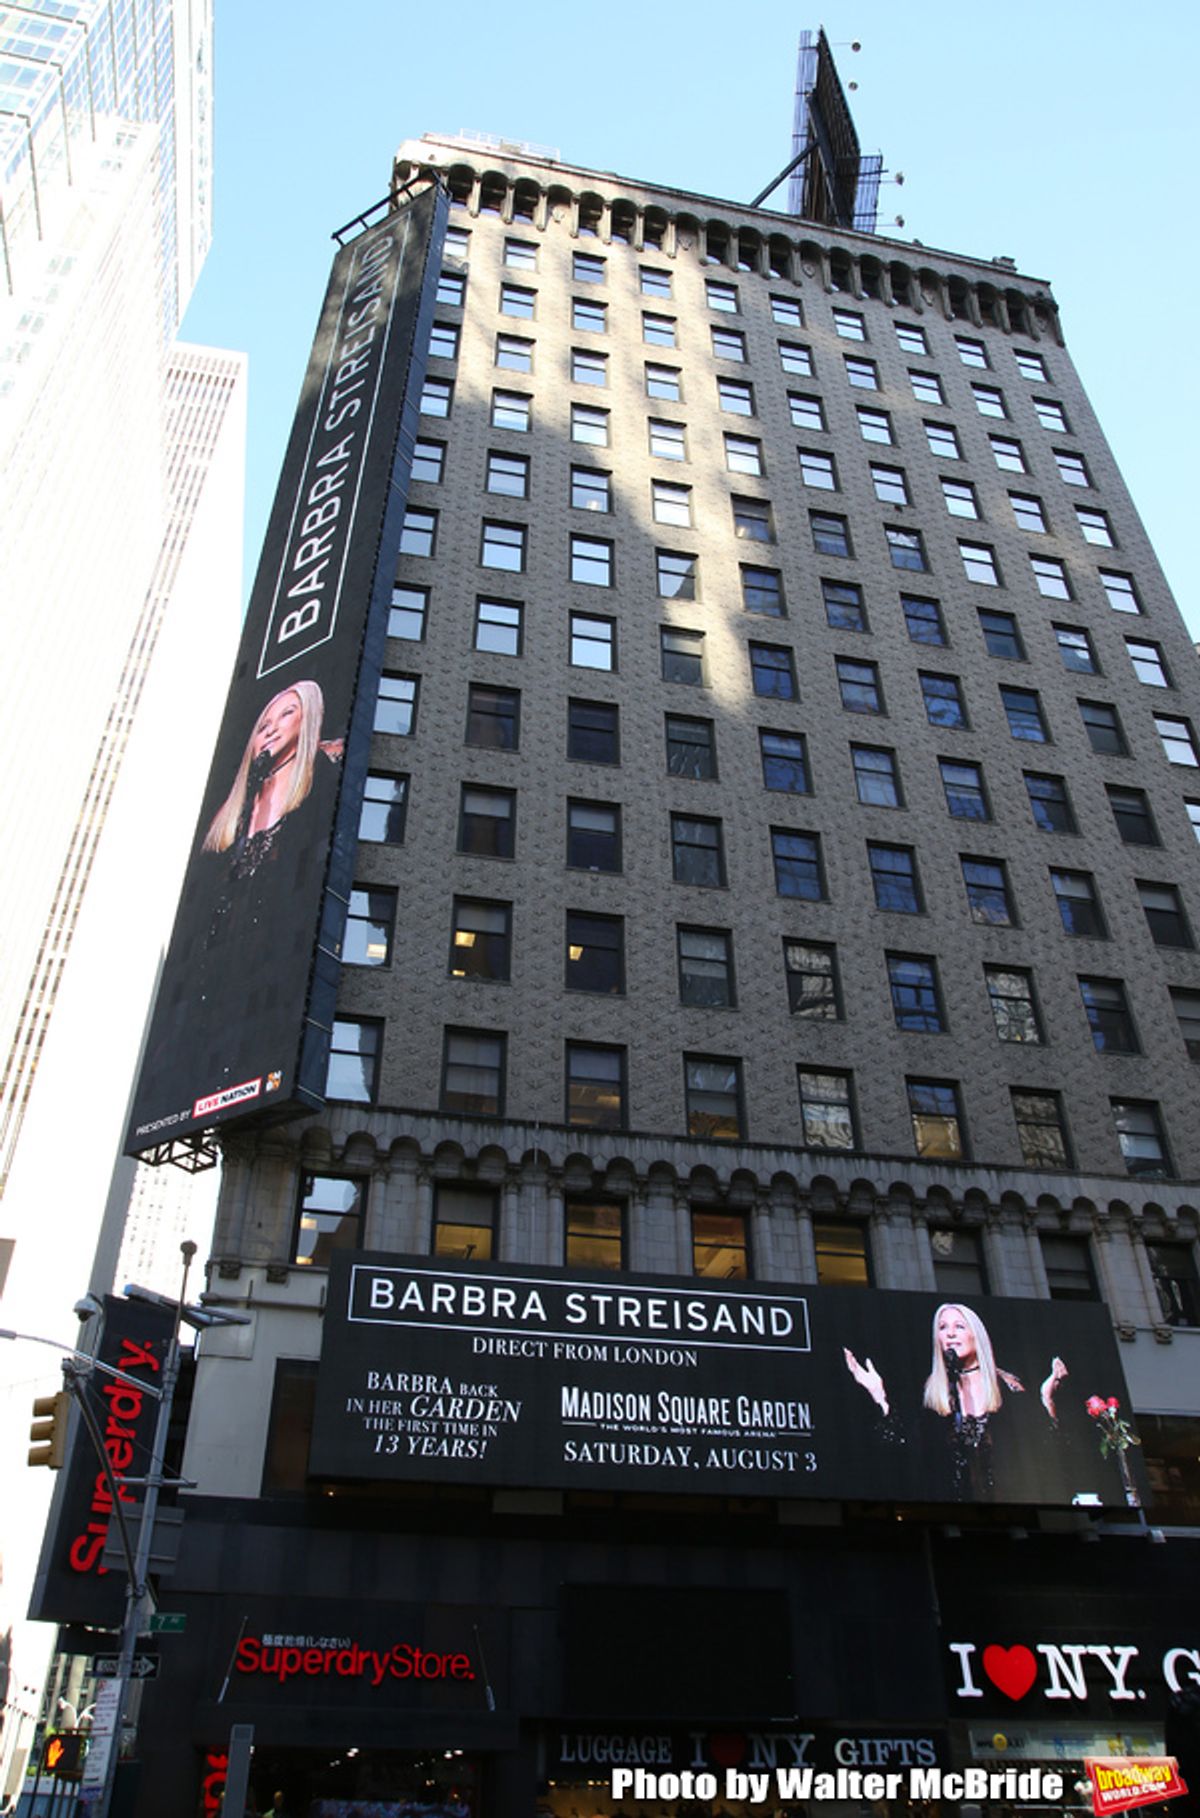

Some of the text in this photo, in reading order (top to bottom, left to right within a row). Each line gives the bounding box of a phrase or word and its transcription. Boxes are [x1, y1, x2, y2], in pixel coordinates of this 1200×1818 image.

[279, 234, 394, 643] BARBRA STREISAND
[220, 1083, 258, 1106] NATION
[370, 1277, 794, 1337] BARBRA STREISAND
[473, 1336, 698, 1368] DIRECT FROM LONDON
[367, 1371, 499, 1399] BARBRA BACK
[346, 1394, 523, 1423] IN HER GARDEN
[561, 1386, 652, 1422] MADISON
[658, 1391, 732, 1426] SQUARE
[363, 1416, 498, 1438] THE FIRST TIME IN
[374, 1434, 488, 1460] 13 YEARS!
[564, 1441, 818, 1473] SATURDAY, AUGUST 3
[949, 1643, 984, 1697] I
[560, 1734, 673, 1764] LUGGAGE
[689, 1731, 707, 1768] I
[834, 1737, 937, 1766] GIFTS
